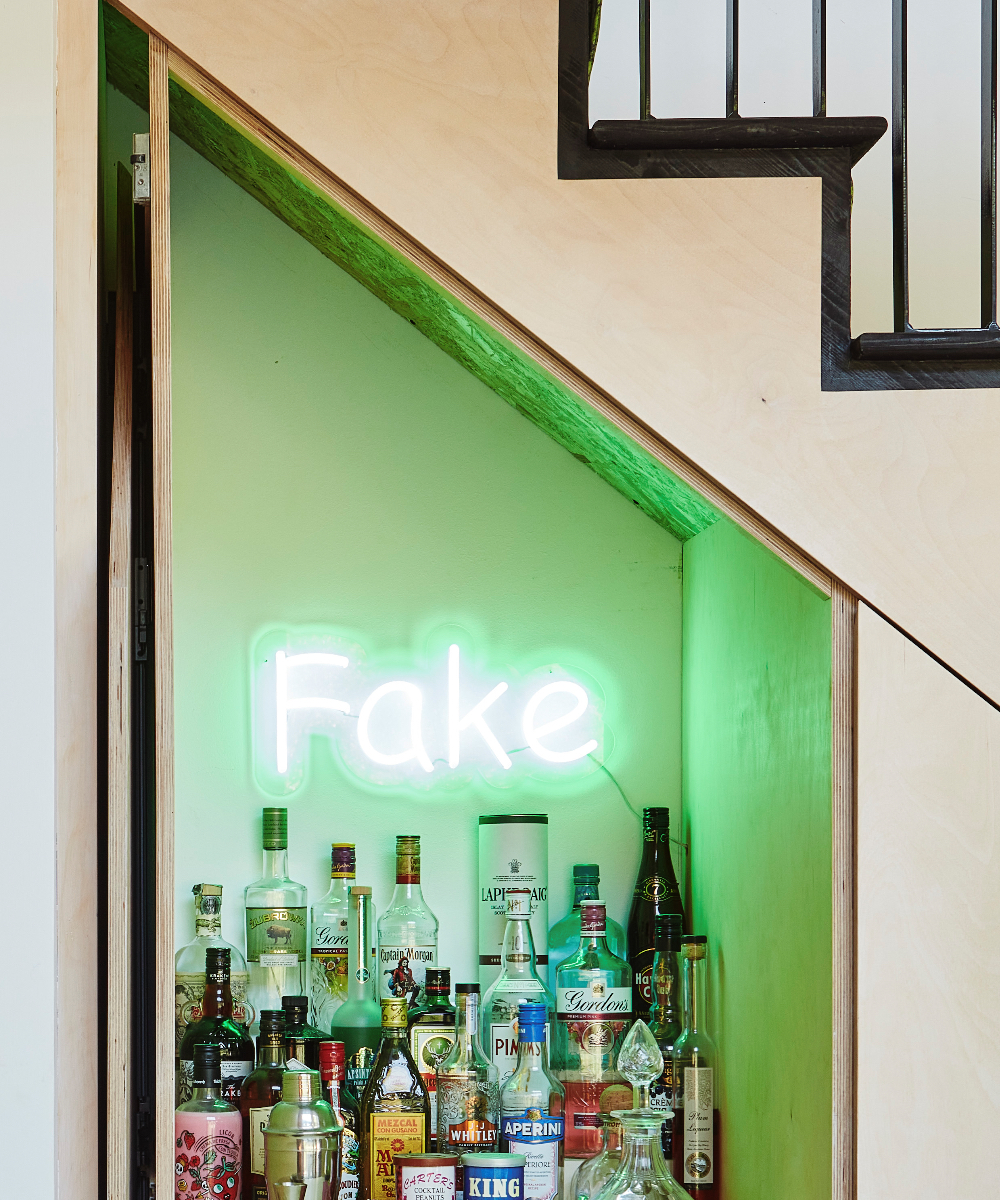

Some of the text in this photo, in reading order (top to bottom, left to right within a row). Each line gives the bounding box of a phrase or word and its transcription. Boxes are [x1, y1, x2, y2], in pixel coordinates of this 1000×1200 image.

[274, 643, 599, 774] Fake
[380, 948, 434, 963] Captain Morgan
[565, 991, 629, 1012] Gordon's
[377, 1119, 418, 1127] MEZCAL
[504, 1121, 561, 1136] APERINI
[451, 1129, 497, 1141] WHITLEY
[403, 1172, 454, 1190] CARTER'S
[468, 1177, 520, 1197] KING
